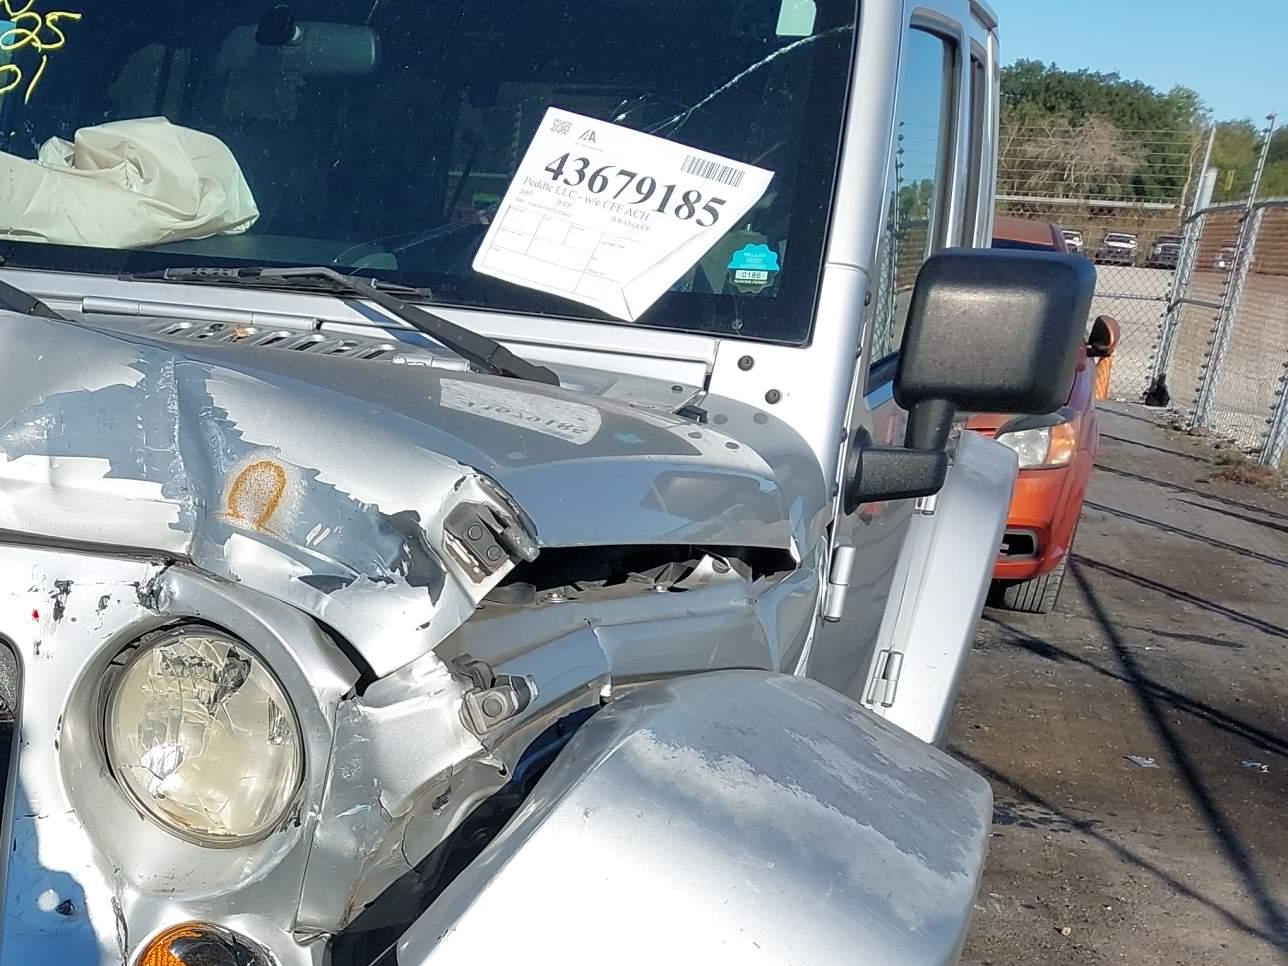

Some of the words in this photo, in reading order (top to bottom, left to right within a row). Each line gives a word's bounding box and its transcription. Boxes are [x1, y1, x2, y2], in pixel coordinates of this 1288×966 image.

[523, 176, 555, 194] Peddle
[556, 186, 578, 200] LLC
[544, 152, 727, 228] 43679185
